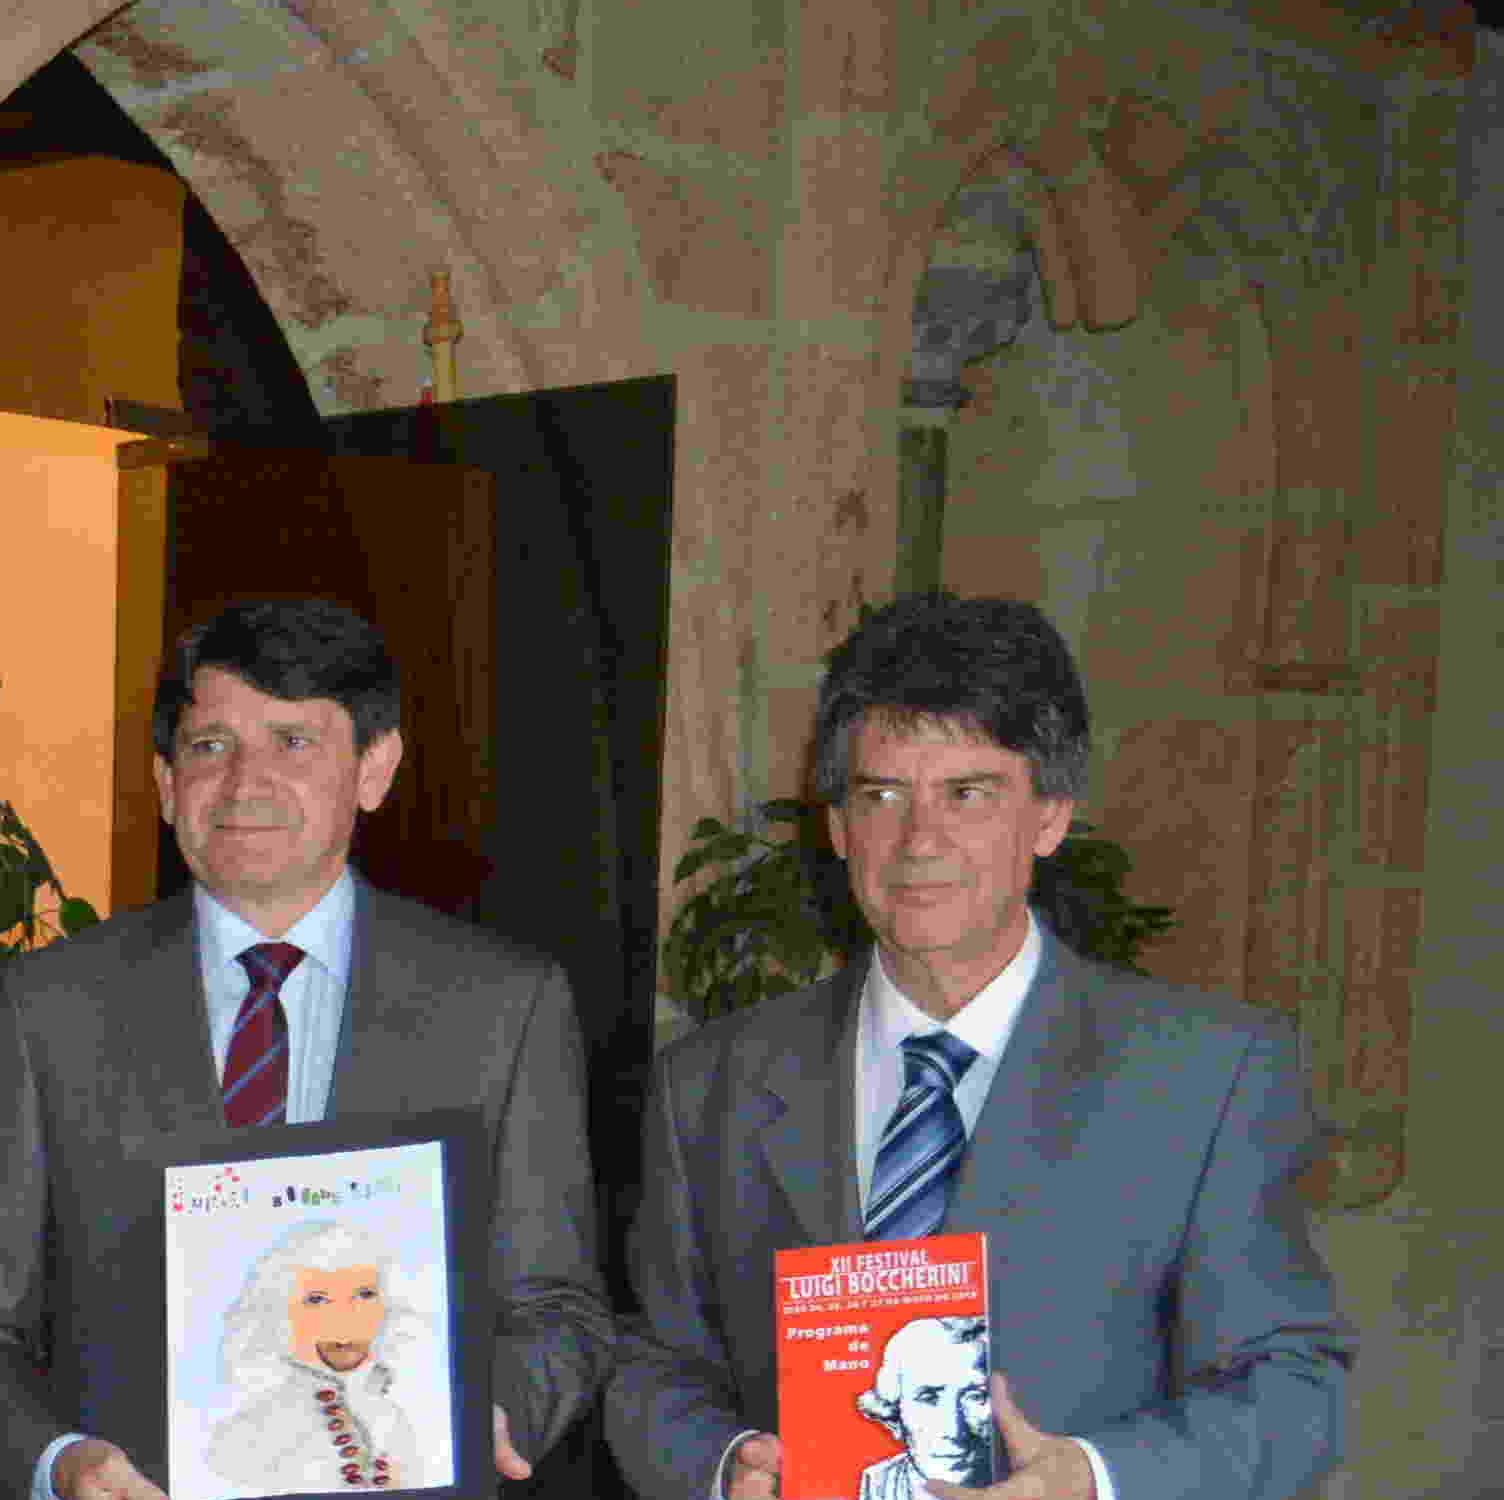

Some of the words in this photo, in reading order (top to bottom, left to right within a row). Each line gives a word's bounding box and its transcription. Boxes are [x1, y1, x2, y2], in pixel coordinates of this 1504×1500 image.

[830, 1255, 851, 1274] XII
[856, 1249, 929, 1272] FESTIVAL
[789, 1274, 841, 1299] LUIGI
[848, 1263, 969, 1295] BOCCHERINI
[786, 1324, 870, 1340] Programa
[848, 1340, 870, 1352] de
[824, 1360, 870, 1371] Mano
